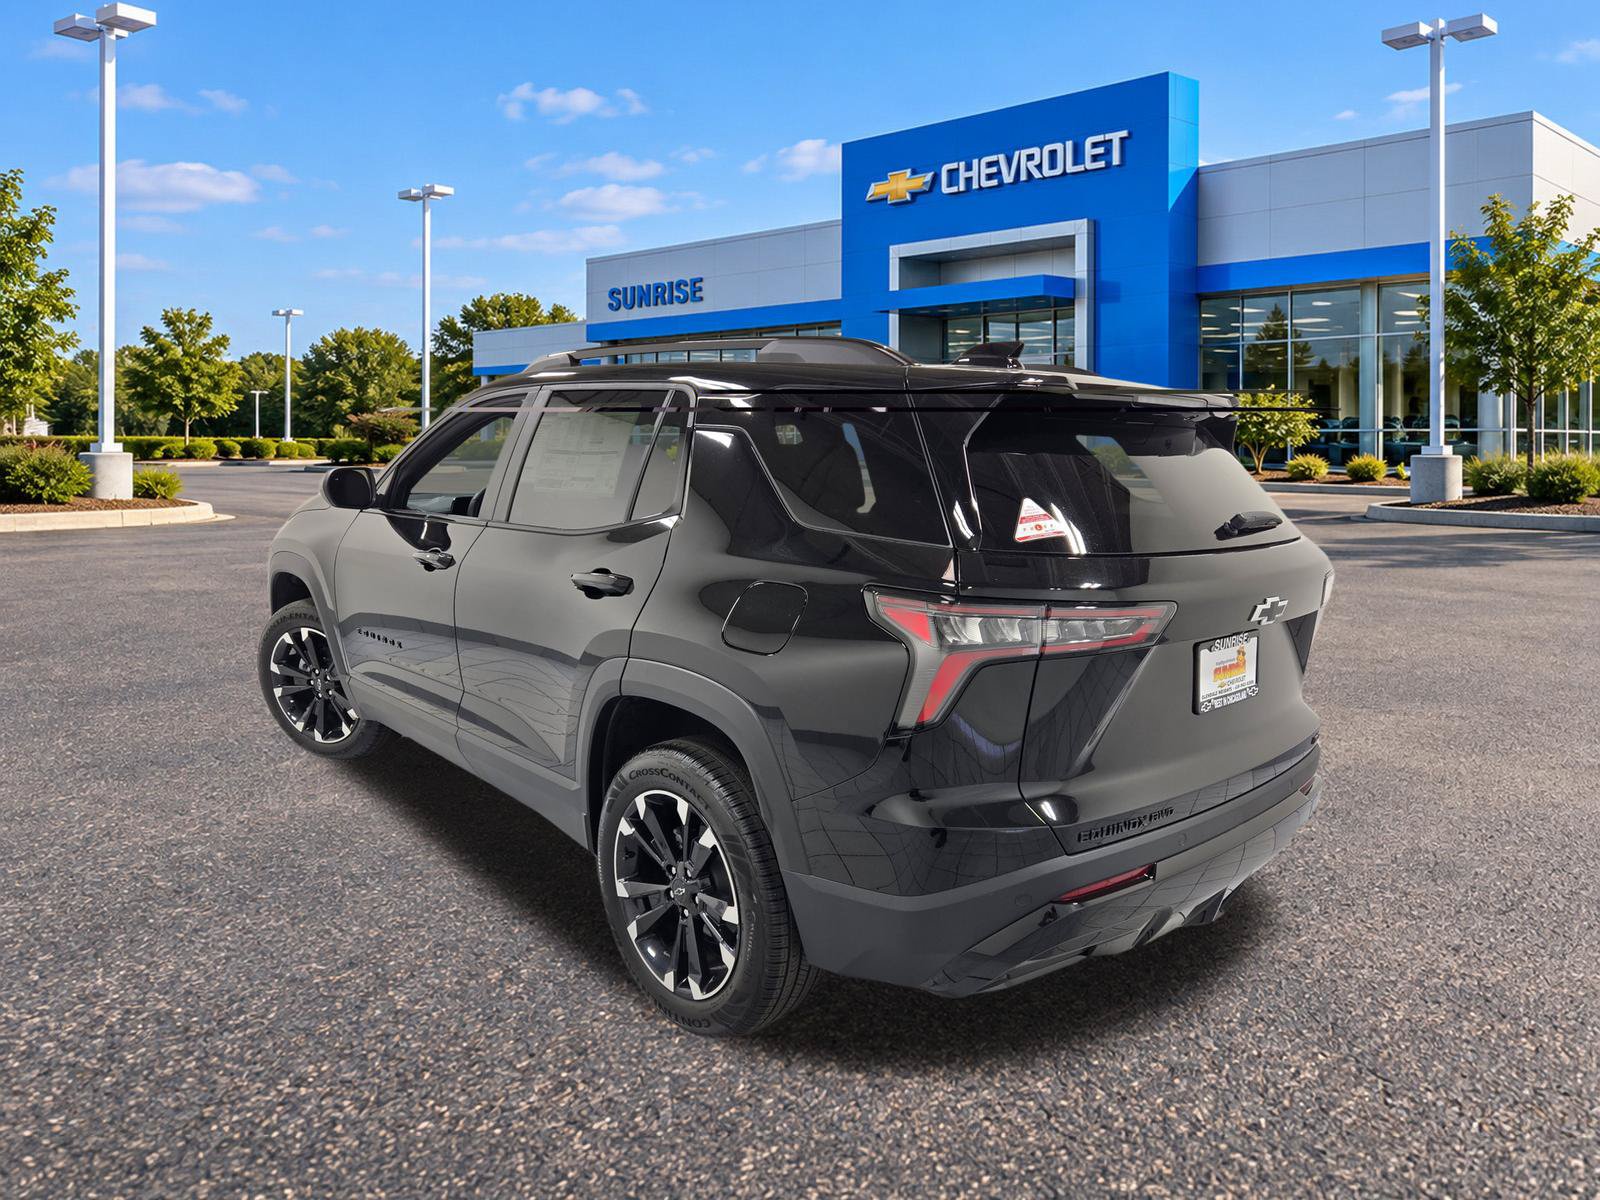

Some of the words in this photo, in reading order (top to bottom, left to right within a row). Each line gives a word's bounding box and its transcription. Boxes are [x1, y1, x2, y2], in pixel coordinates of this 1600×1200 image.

[941, 130, 1129, 194] CHEVROLET
[608, 277, 704, 312] SUNRISE
[1214, 633, 1249, 652] SUNRISE
[1077, 814, 1147, 843] EQUINOX
[1149, 806, 1175, 822] AWD
